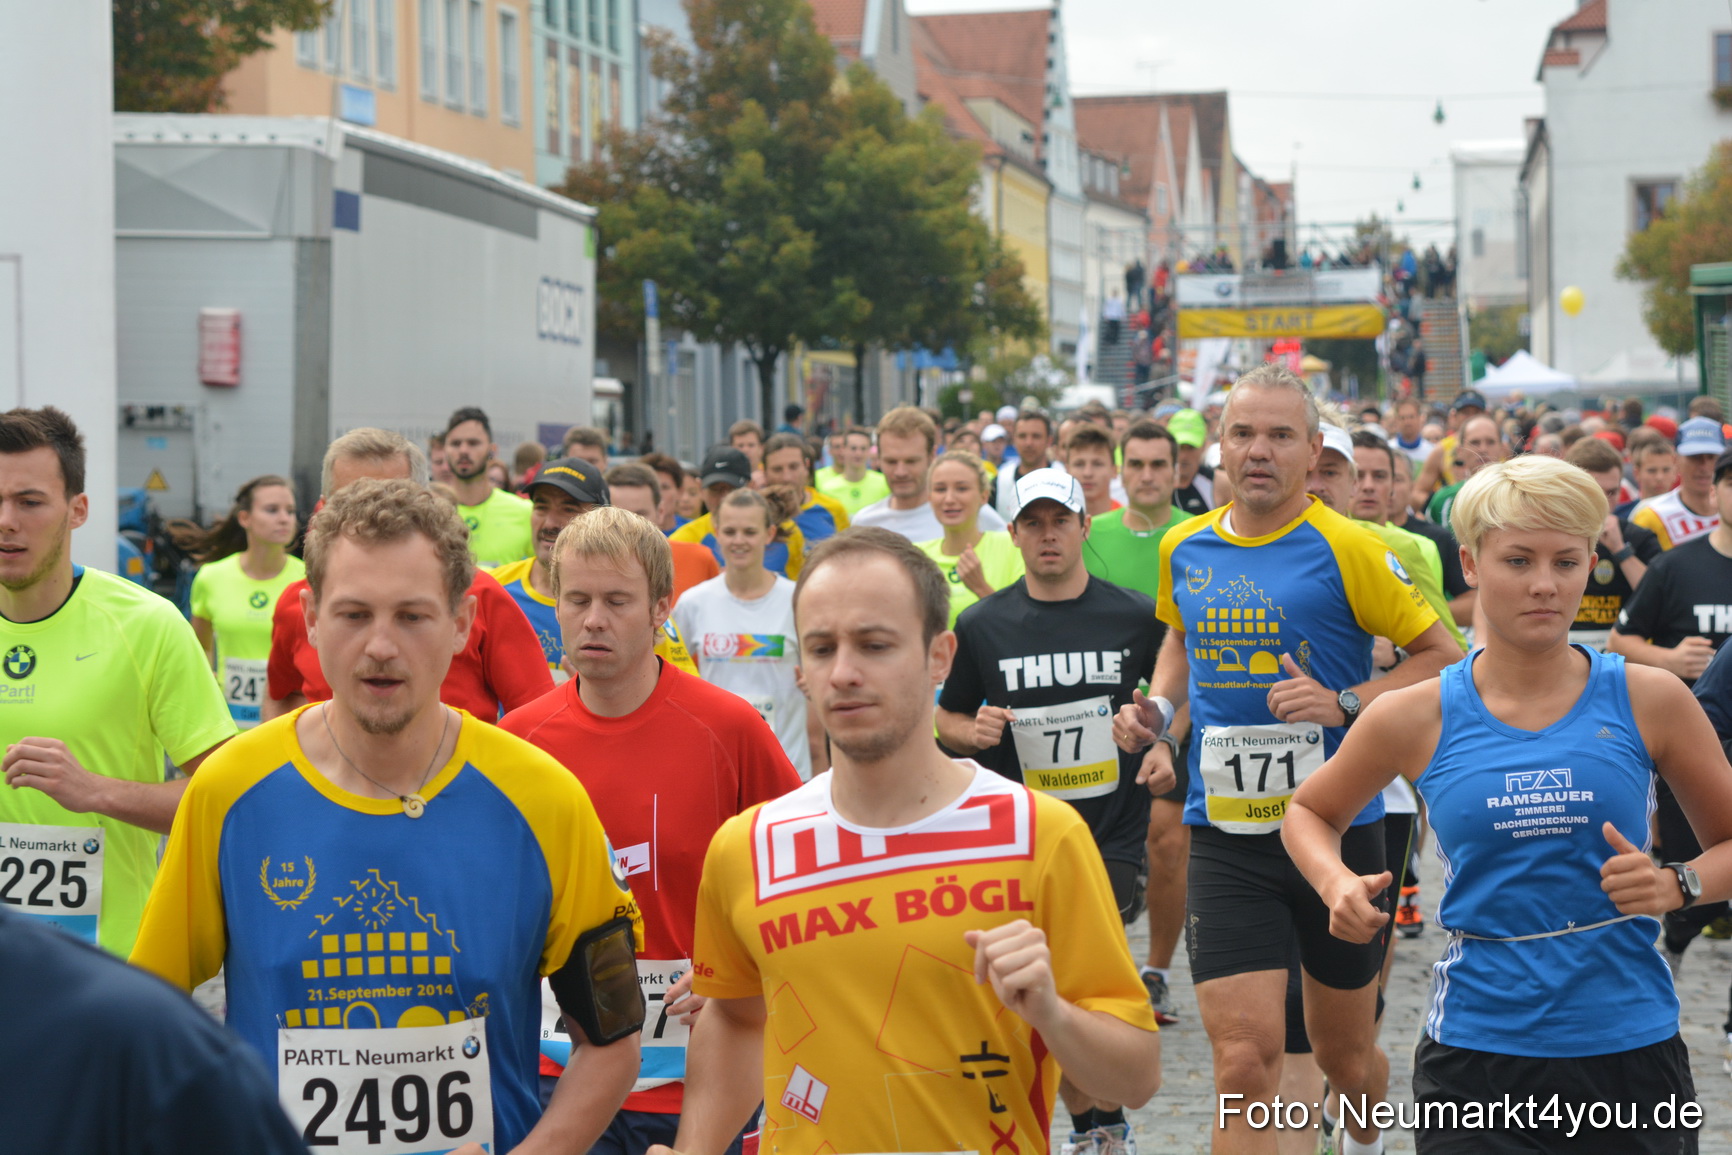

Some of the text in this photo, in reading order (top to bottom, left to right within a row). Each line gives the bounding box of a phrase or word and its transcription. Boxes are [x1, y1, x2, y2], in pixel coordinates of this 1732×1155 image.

[1244, 313, 1315, 331] START
[1200, 638, 1281, 647] 21.September 2014
[998, 651, 1122, 692] THULE
[230, 676, 266, 701] 24
[1013, 710, 1094, 727] PARTL Neumarkt
[1043, 726, 1083, 763] 77
[1204, 735, 1301, 748] PARTL Neumarkt
[1039, 770, 1104, 788] Waldemar
[1225, 750, 1296, 792] 171
[1486, 791, 1594, 808] RAMSAUER
[1245, 800, 1286, 818] Josef
[1515, 805, 1566, 816] ZIMMEREI
[1494, 816, 1589, 830] DACHEINDECKUNG
[1512, 827, 1572, 839] GERÜSTBAU
[10, 837, 77, 852] Neumarkt
[280, 862, 295, 872] 15
[272, 878, 305, 888] Jahre
[758, 874, 1034, 955] MAX BÖGL
[306, 983, 454, 1002] 21.September 2014
[284, 1046, 455, 1066] PARTL Neumarkt
[302, 1070, 474, 1146] 2496
